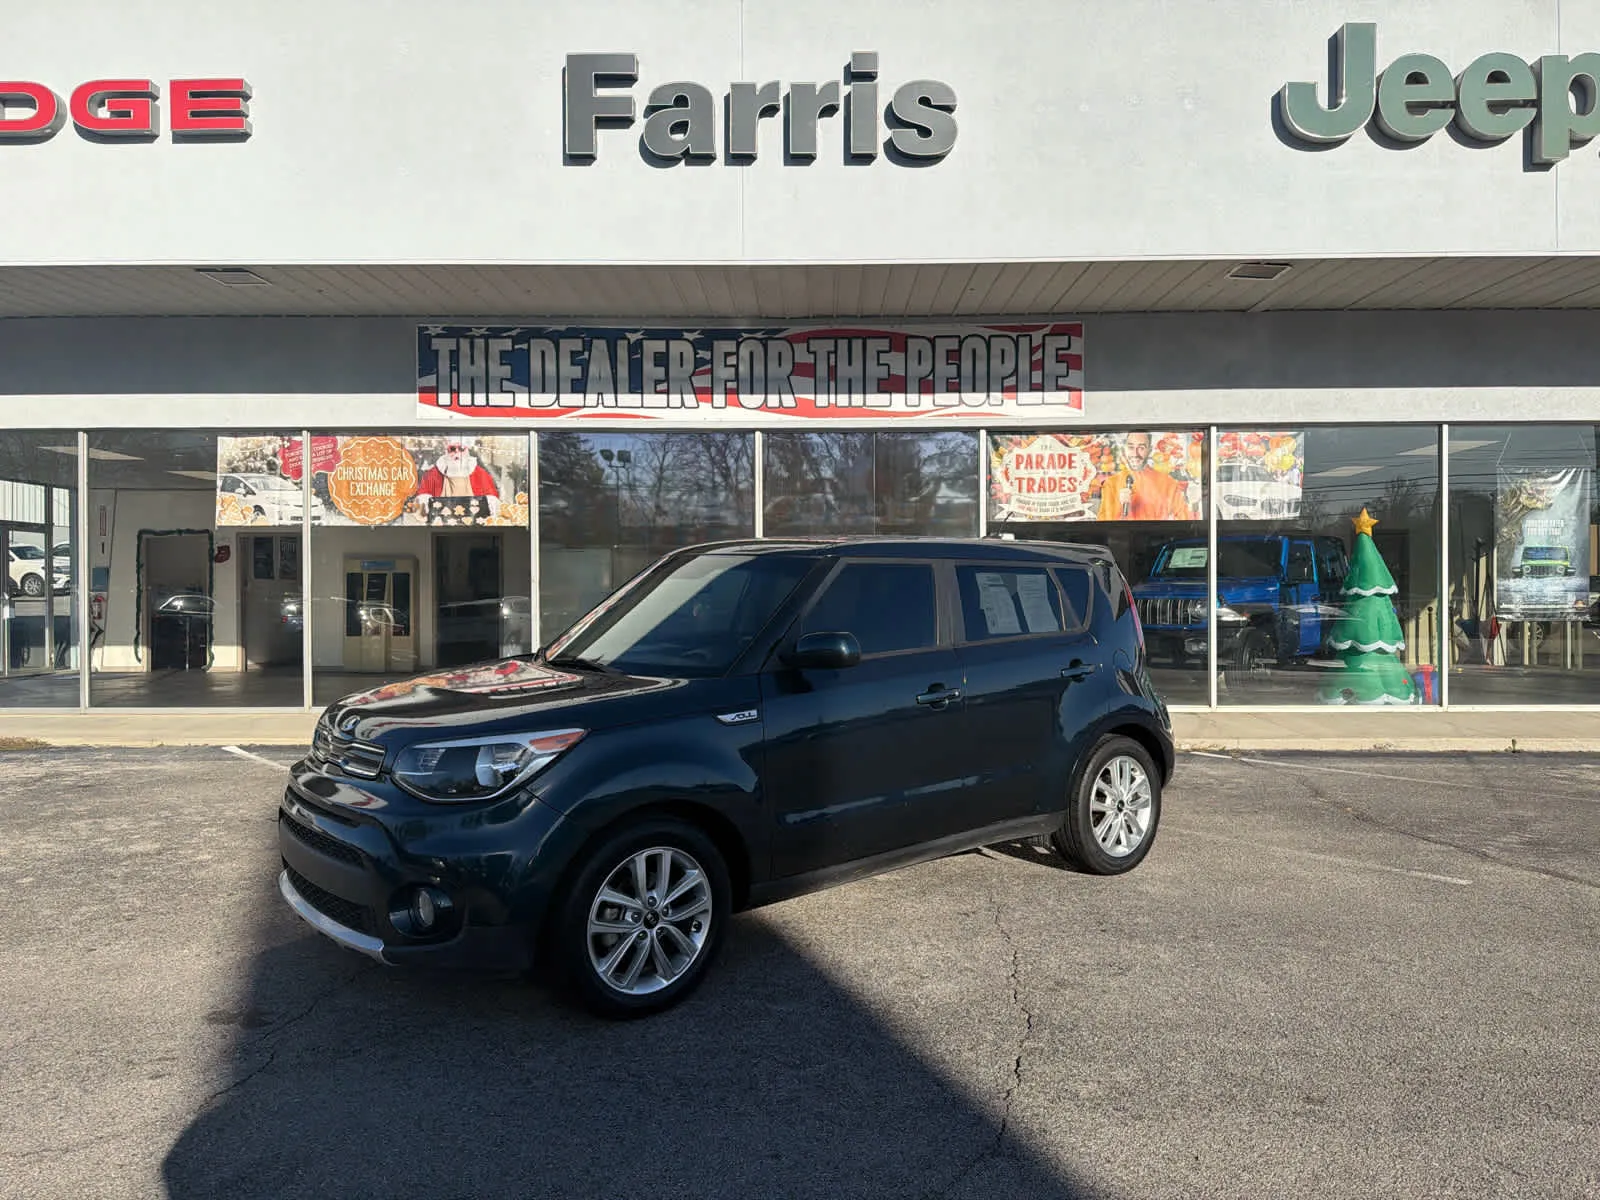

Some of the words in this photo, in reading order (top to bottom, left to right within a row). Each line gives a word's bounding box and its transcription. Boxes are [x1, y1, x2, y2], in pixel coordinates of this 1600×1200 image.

[1276, 22, 1600, 168] Jeep
[562, 51, 958, 167] Farris
[430, 335, 516, 408] THE
[528, 336, 700, 409] DEALER
[711, 336, 797, 409] FOR
[807, 335, 892, 408] THE
[904, 333, 1072, 407] PEOPLE
[1015, 453, 1078, 470] PARADE
[337, 466, 388, 481] CHRISTMAS
[391, 466, 409, 481] CAR
[350, 481, 396, 497] EXCHANGE
[1015, 477, 1078, 494] TRADES
